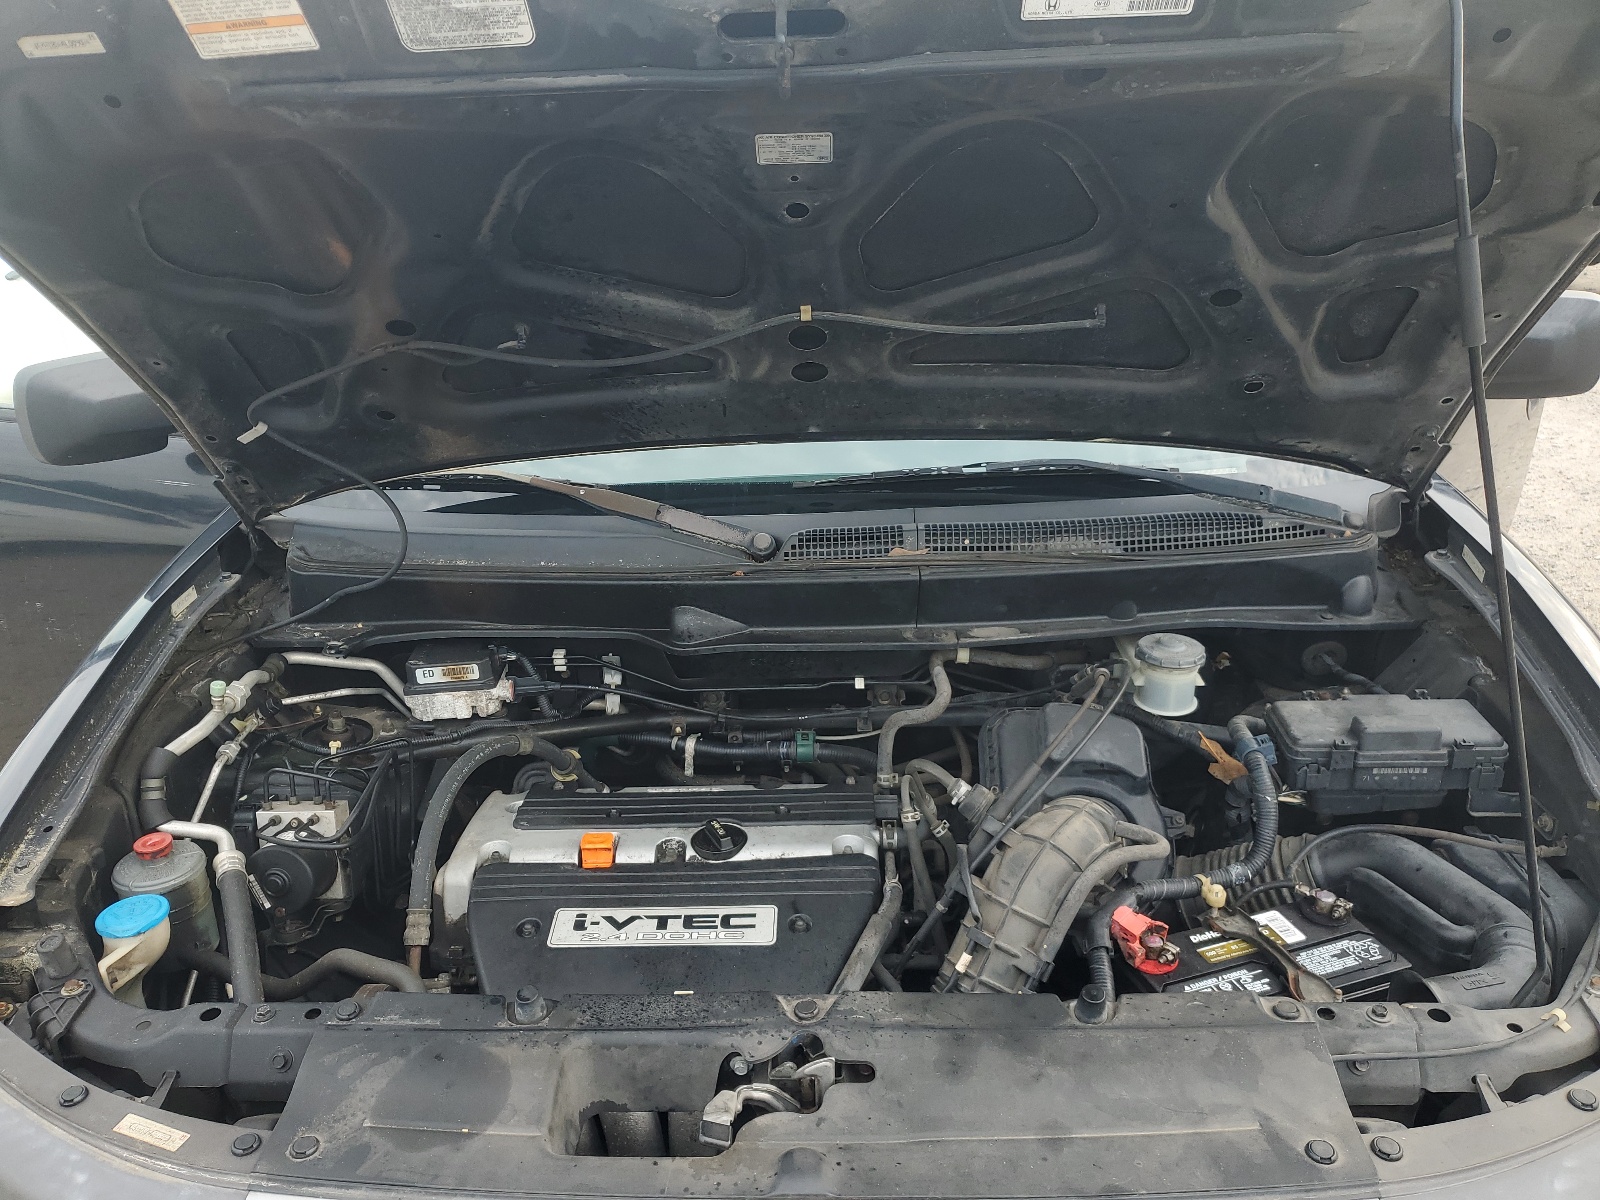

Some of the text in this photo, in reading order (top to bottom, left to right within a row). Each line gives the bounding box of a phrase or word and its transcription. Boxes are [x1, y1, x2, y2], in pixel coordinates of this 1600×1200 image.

[231, 19, 268, 29] WARNING
[422, 669, 435, 679] ED
[572, 912, 757, 932] i-VTEC
[580, 930, 745, 942] 2.4 DOHC
[1189, 977, 1219, 989] DANGER
[1222, 968, 1249, 980] POISON
